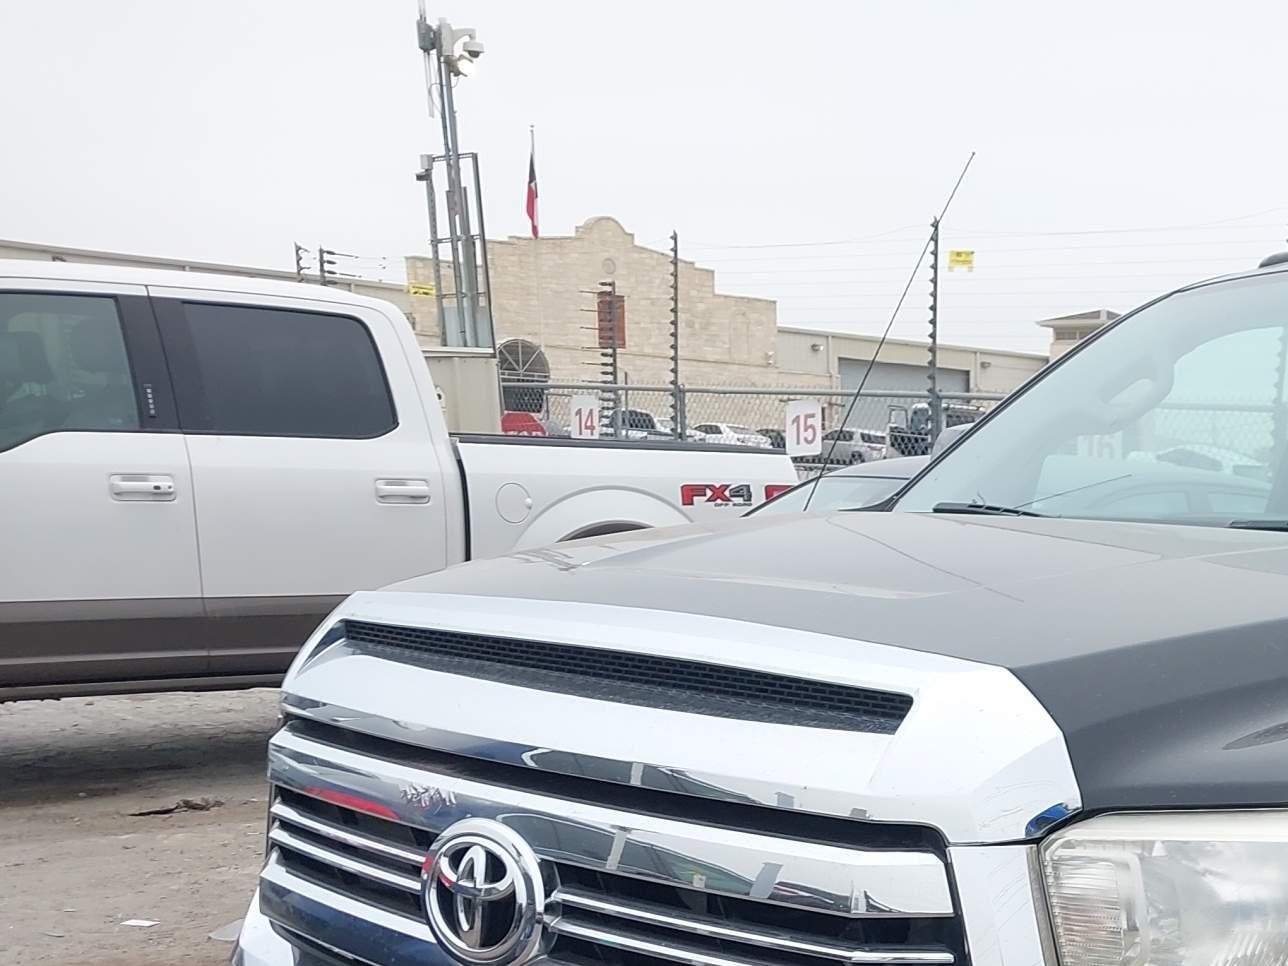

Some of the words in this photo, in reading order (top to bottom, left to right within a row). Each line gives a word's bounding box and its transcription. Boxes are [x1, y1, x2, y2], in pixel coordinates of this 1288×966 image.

[575, 407, 596, 436] 14
[791, 412, 817, 446] 15
[681, 484, 752, 506] FX4
